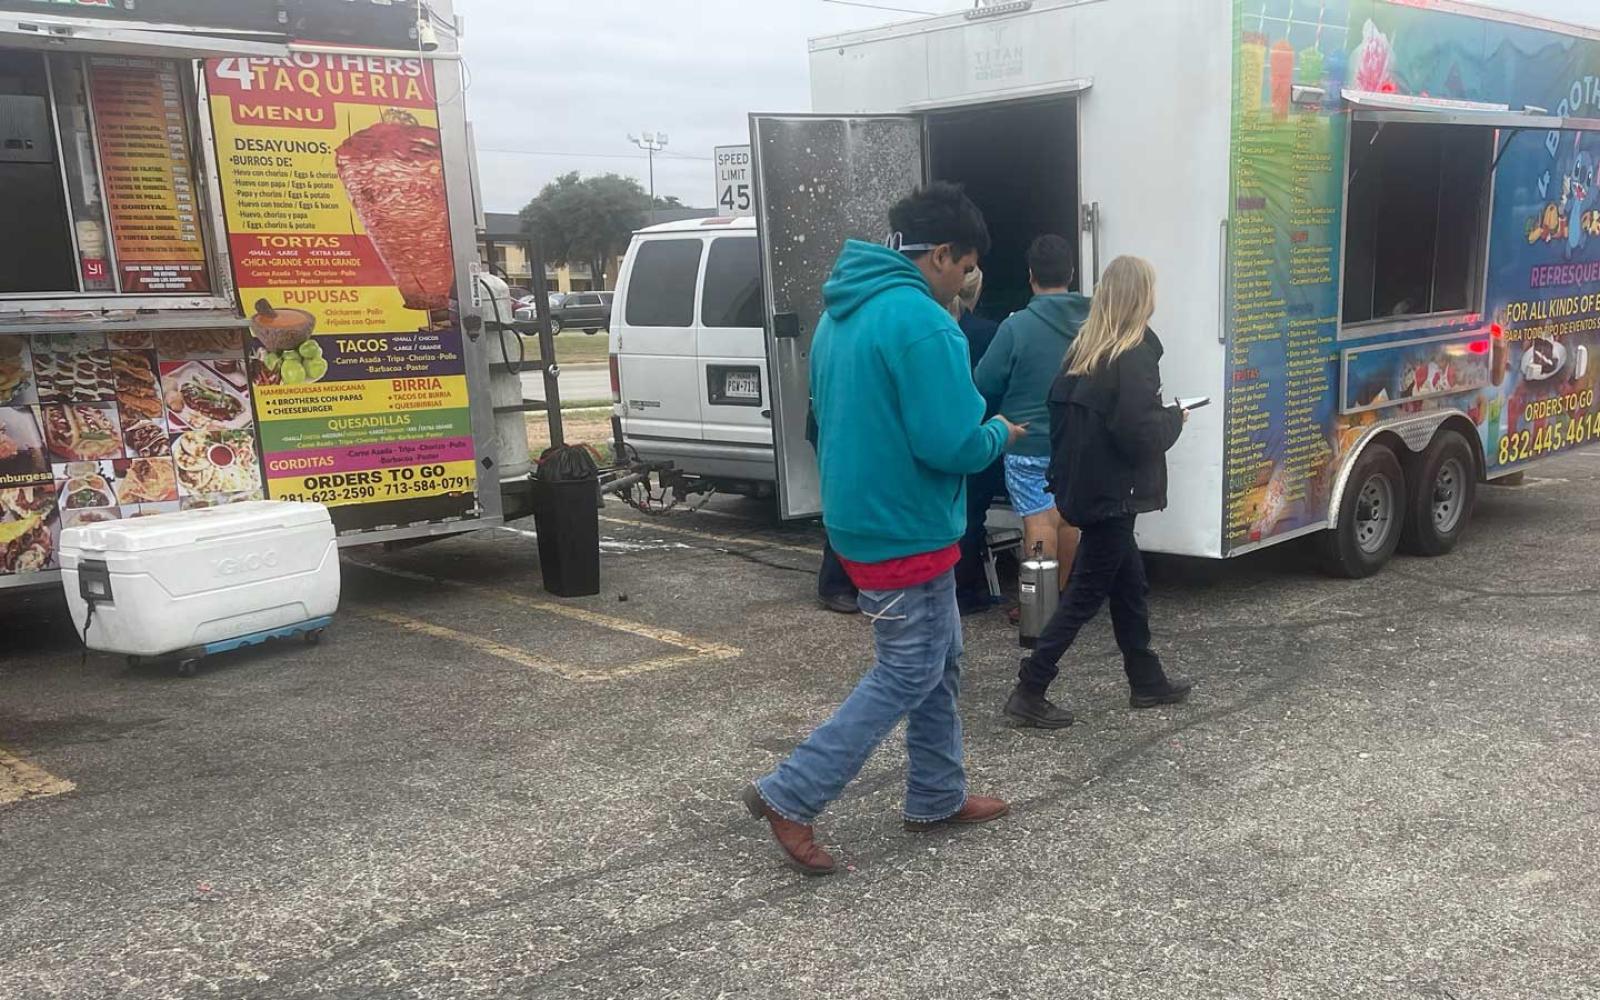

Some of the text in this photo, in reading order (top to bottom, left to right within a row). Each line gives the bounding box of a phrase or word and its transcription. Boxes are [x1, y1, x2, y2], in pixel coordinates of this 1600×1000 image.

[216, 57, 254, 90] 4
[253, 66, 423, 100] TAQUERIA
[238, 104, 324, 122] MENU
[234, 138, 332, 154] DESAYUNOS:
[233, 155, 293, 167] BURROS DE:
[718, 153, 749, 166] SPEED
[294, 171, 309, 179] Eggs
[722, 169, 746, 181] LIMIT
[291, 181, 306, 189] Eggs
[288, 191, 303, 199] Eggs
[720, 184, 750, 211] 45
[299, 201, 313, 209] Eggs
[257, 236, 341, 248] TORTAS
[332, 258, 361, 267] GRANDE
[1530, 263, 1600, 288] REFRESQUE
[283, 290, 359, 304] PUPUSAS
[1506, 302, 1527, 322] FOR
[1529, 300, 1547, 320] ALL
[1548, 297, 1579, 318] KINDS
[1580, 295, 1595, 312] OF
[1560, 322, 1569, 334] DE
[1569, 318, 1597, 333] EVENTOS
[335, 339, 388, 353] TACOS
[359, 356, 381, 364] Asada
[387, 355, 405, 363] Tripa
[260, 384, 365, 396] HAMBURGUESAS MEXICANAS
[392, 378, 442, 391] BIRRIA
[278, 397, 320, 405] BROTHERS
[339, 394, 363, 402] PAPAS
[1525, 390, 1593, 422] ORDERS TO GO
[273, 405, 333, 415] CHEESEBURGER
[328, 414, 411, 430] QUESADILLAS
[1499, 412, 1600, 464] 832.445.4614
[269, 456, 334, 471] GORDITAS
[304, 465, 445, 490] ORDERS TO GO
[281, 476, 470, 503] 281-623-2590 713-584-0791
